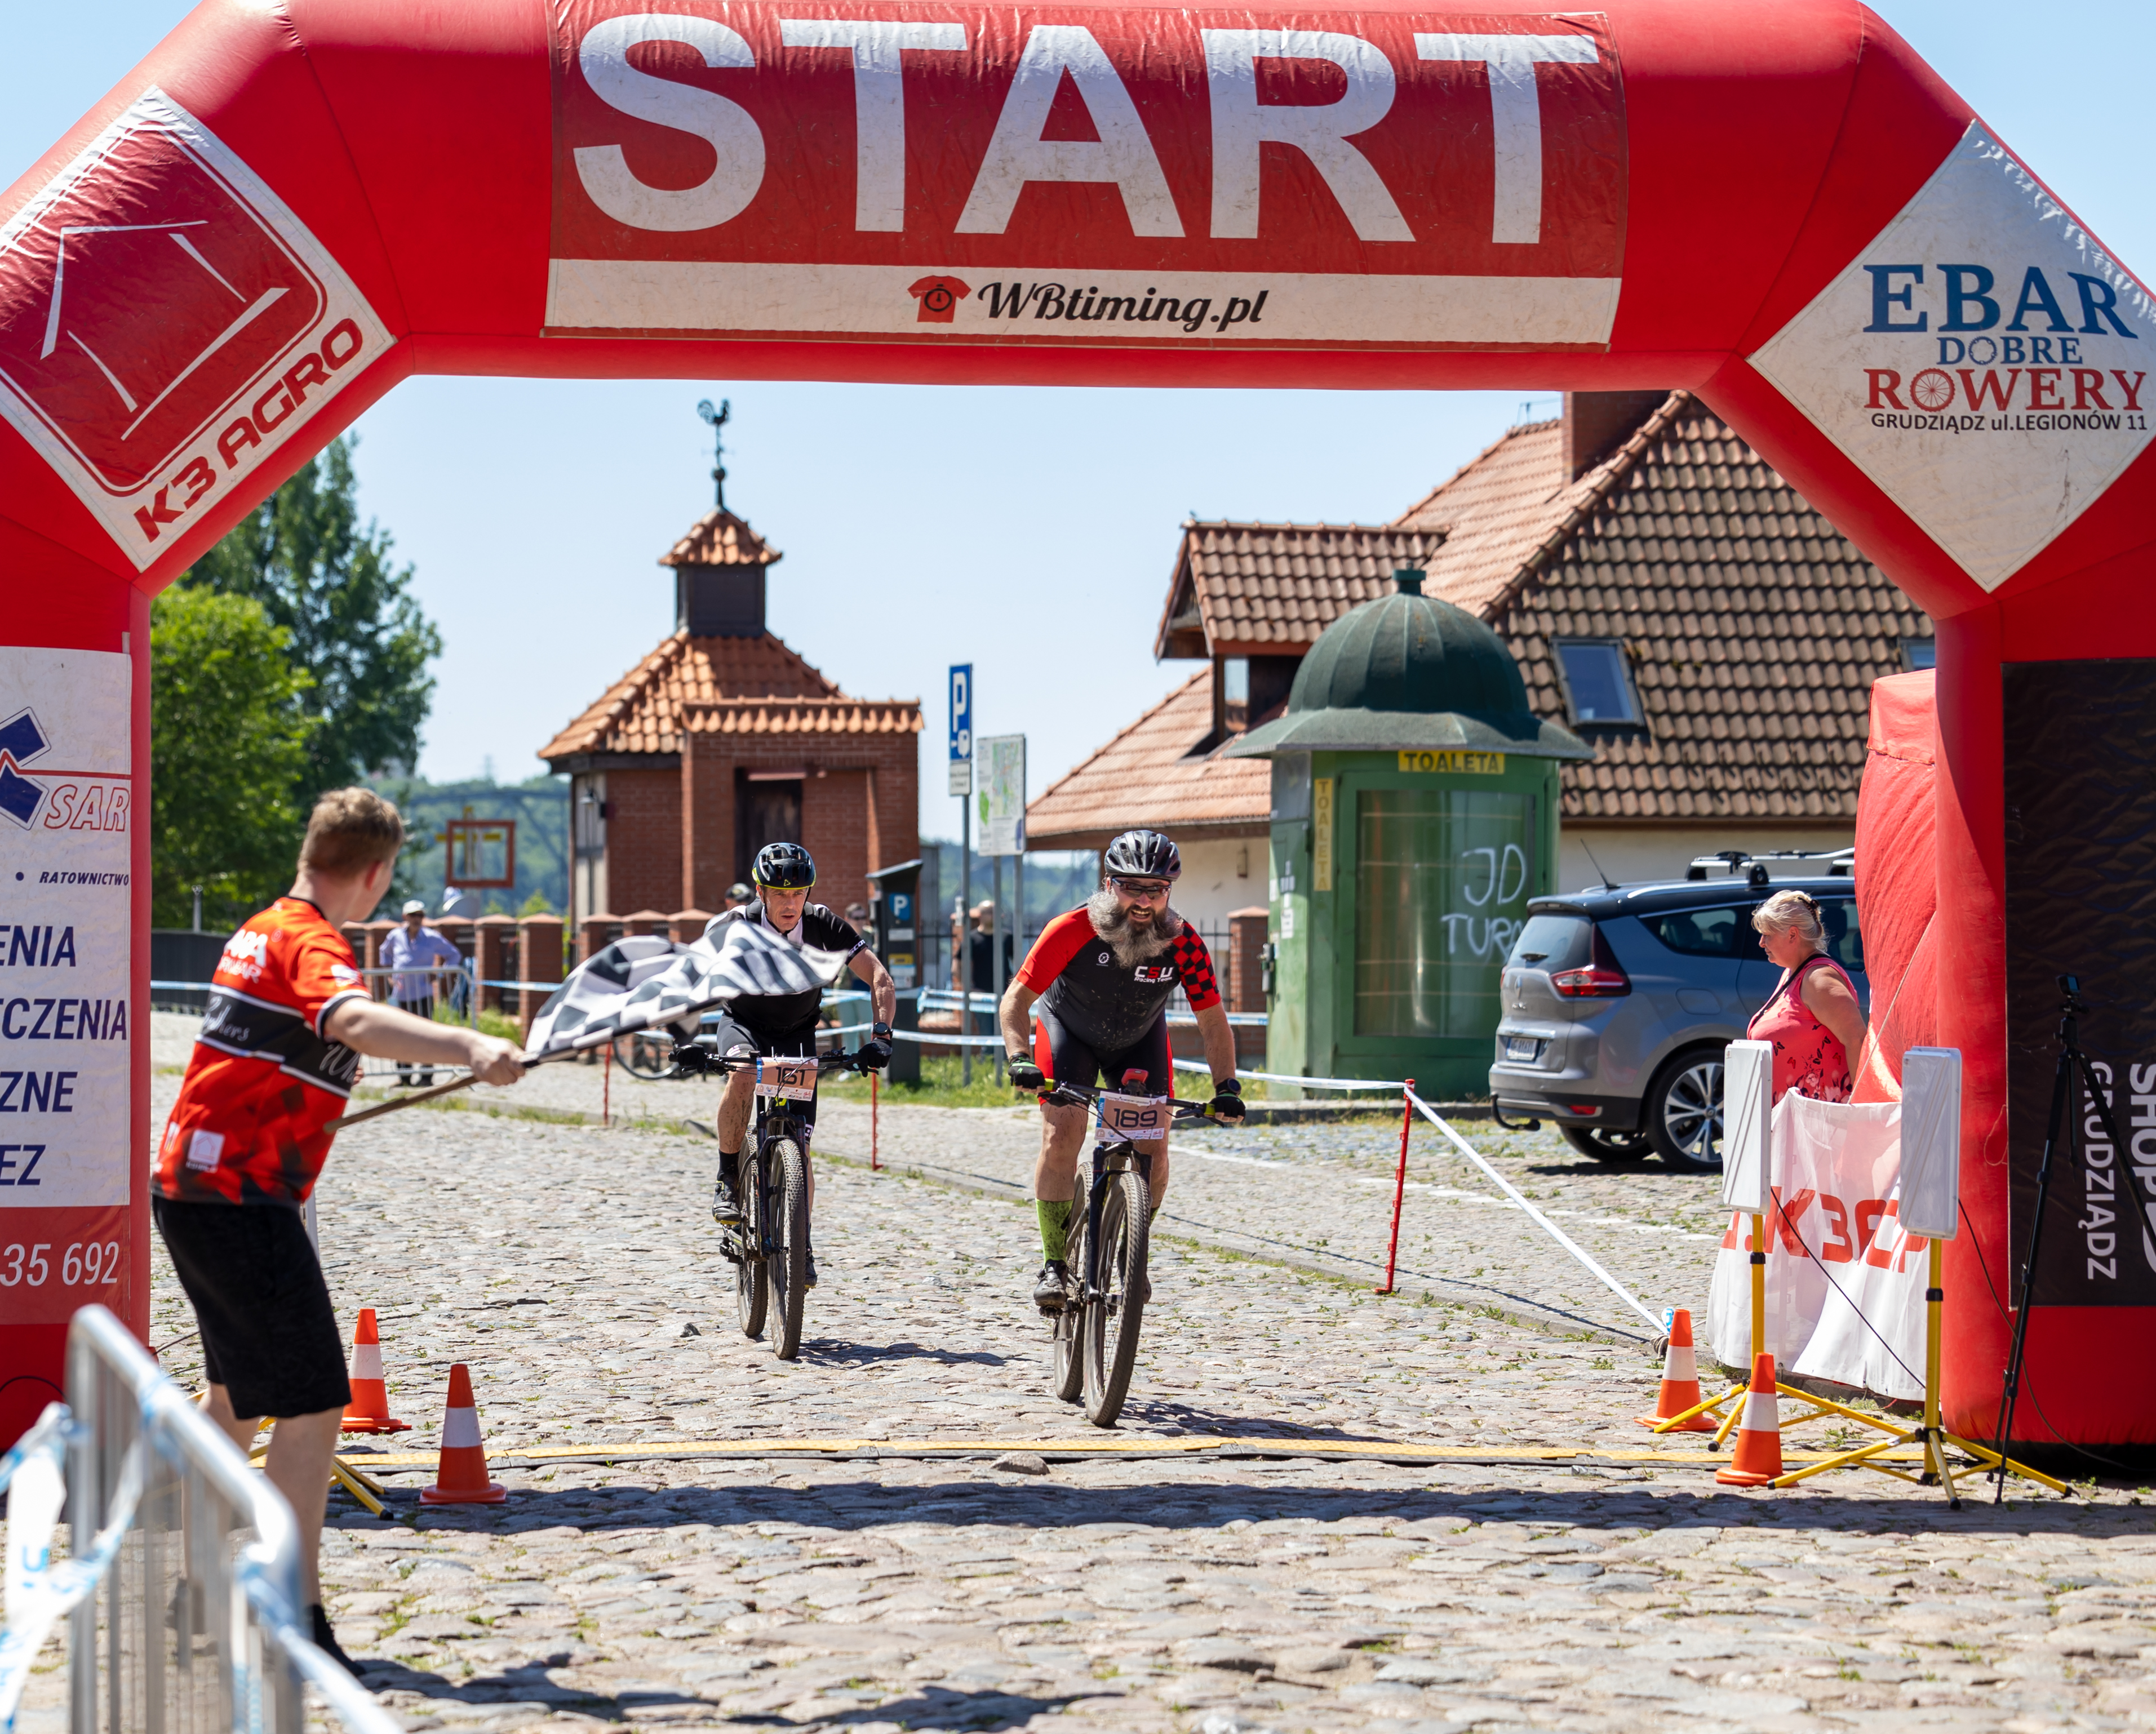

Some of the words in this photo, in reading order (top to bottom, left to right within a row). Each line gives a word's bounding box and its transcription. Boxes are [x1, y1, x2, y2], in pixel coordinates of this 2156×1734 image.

[573, 12, 1599, 245] START
[978, 282, 1268, 332] WBtiming.pl
[1863, 264, 2139, 339] EBAR
[1936, 336, 2083, 365] DOBRE
[1863, 367, 2146, 412] ROWERY
[134, 456, 216, 543] K3
[217, 318, 363, 470] AGRO
[1871, 413, 1985, 434] GRUDZIĄDZ
[1991, 411, 2120, 430] ul.LEGIONÓW
[2127, 415, 2148, 430] 11
[952, 672, 967, 732] P
[1404, 752, 1499, 773] TOALETA
[44, 784, 130, 832] SAR
[1317, 780, 1329, 890] TOALETA
[39, 871, 129, 886] RATOWNICTWO
[1462, 843, 1527, 906] JD
[894, 895, 908, 917] P
[0, 998, 127, 1040] CZENIA
[775, 1066, 806, 1086] 161
[1114, 1108, 1157, 1128] 189
[0, 1244, 51, 1287] 35
[62, 1242, 119, 1285] 692
